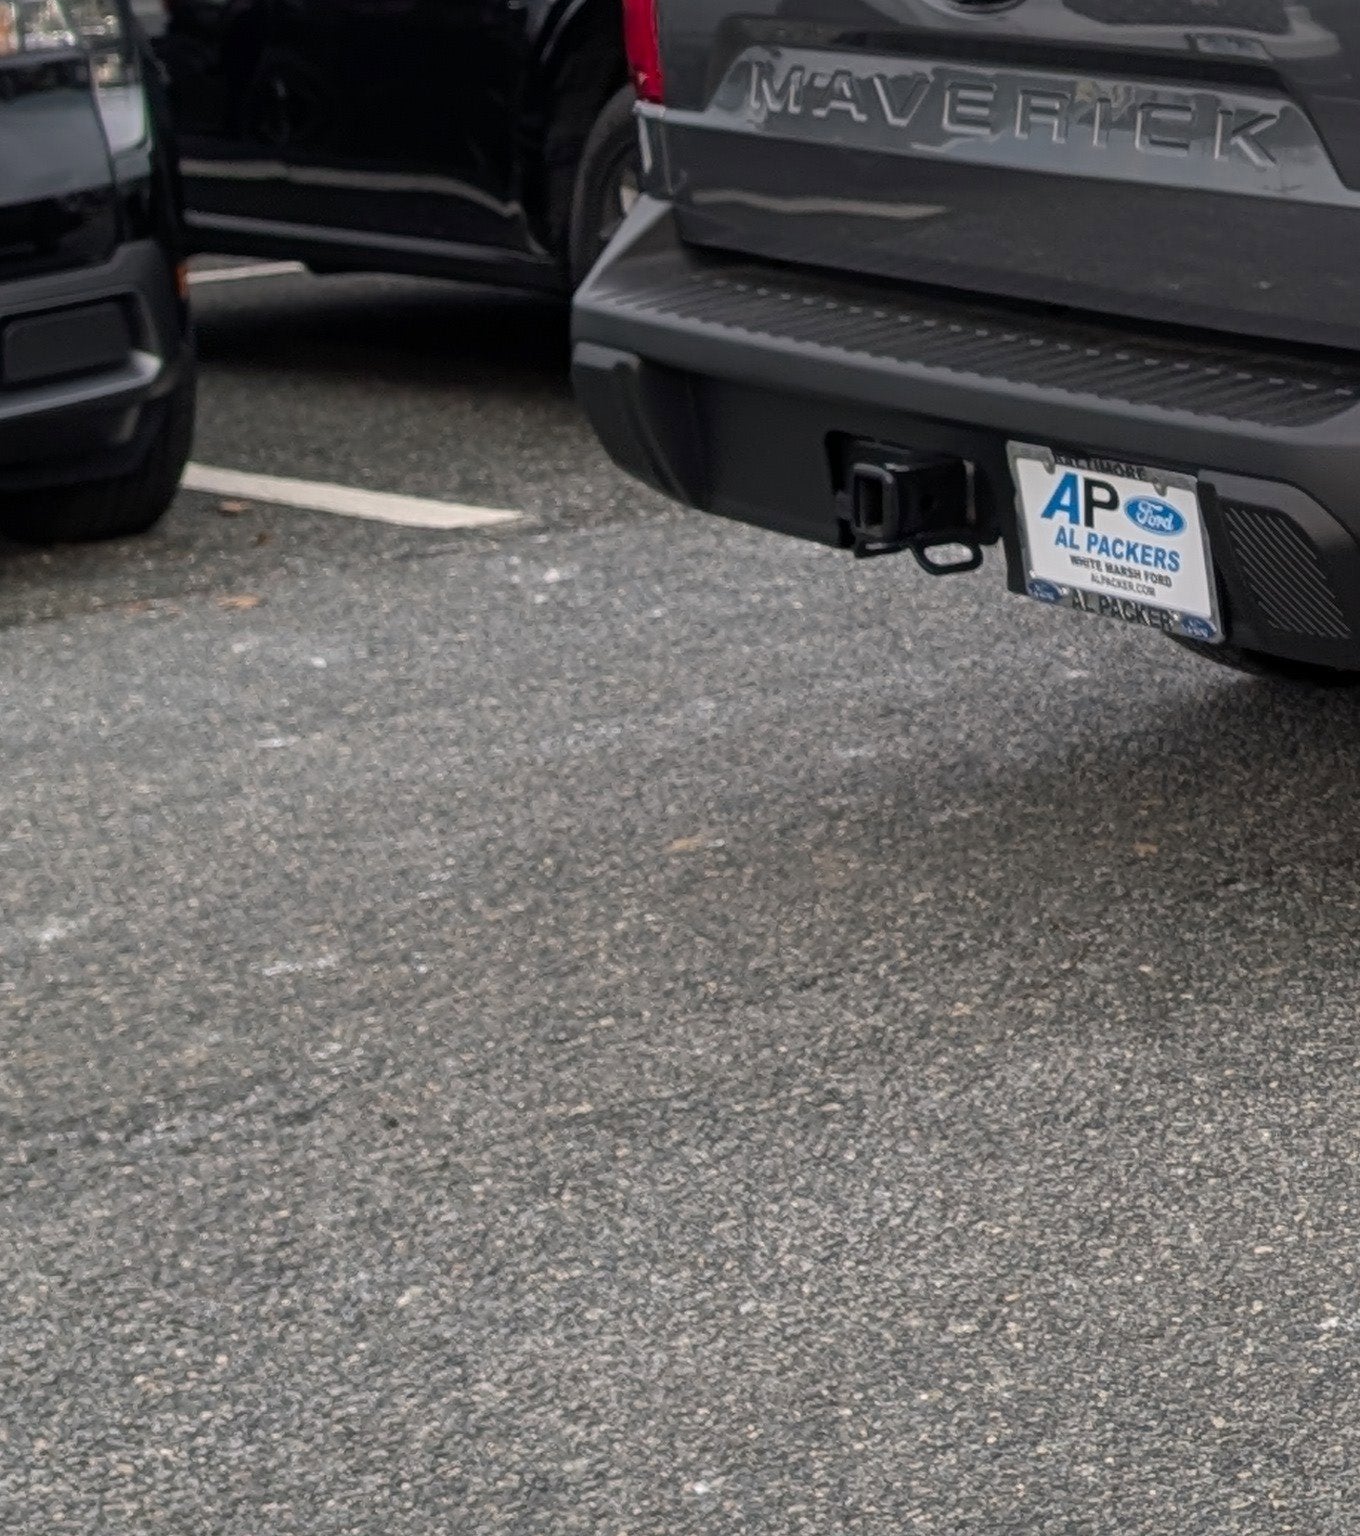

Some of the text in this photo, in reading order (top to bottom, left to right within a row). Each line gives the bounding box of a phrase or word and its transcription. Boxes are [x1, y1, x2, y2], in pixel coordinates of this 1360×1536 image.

[749, 62, 1278, 169] MAVERICK
[1041, 471, 1120, 529] AP
[1136, 500, 1176, 533] Ford
[1054, 525, 1181, 573] AL PACKERS
[1143, 570, 1173, 588] FORD
[1072, 587, 1096, 614] AL
